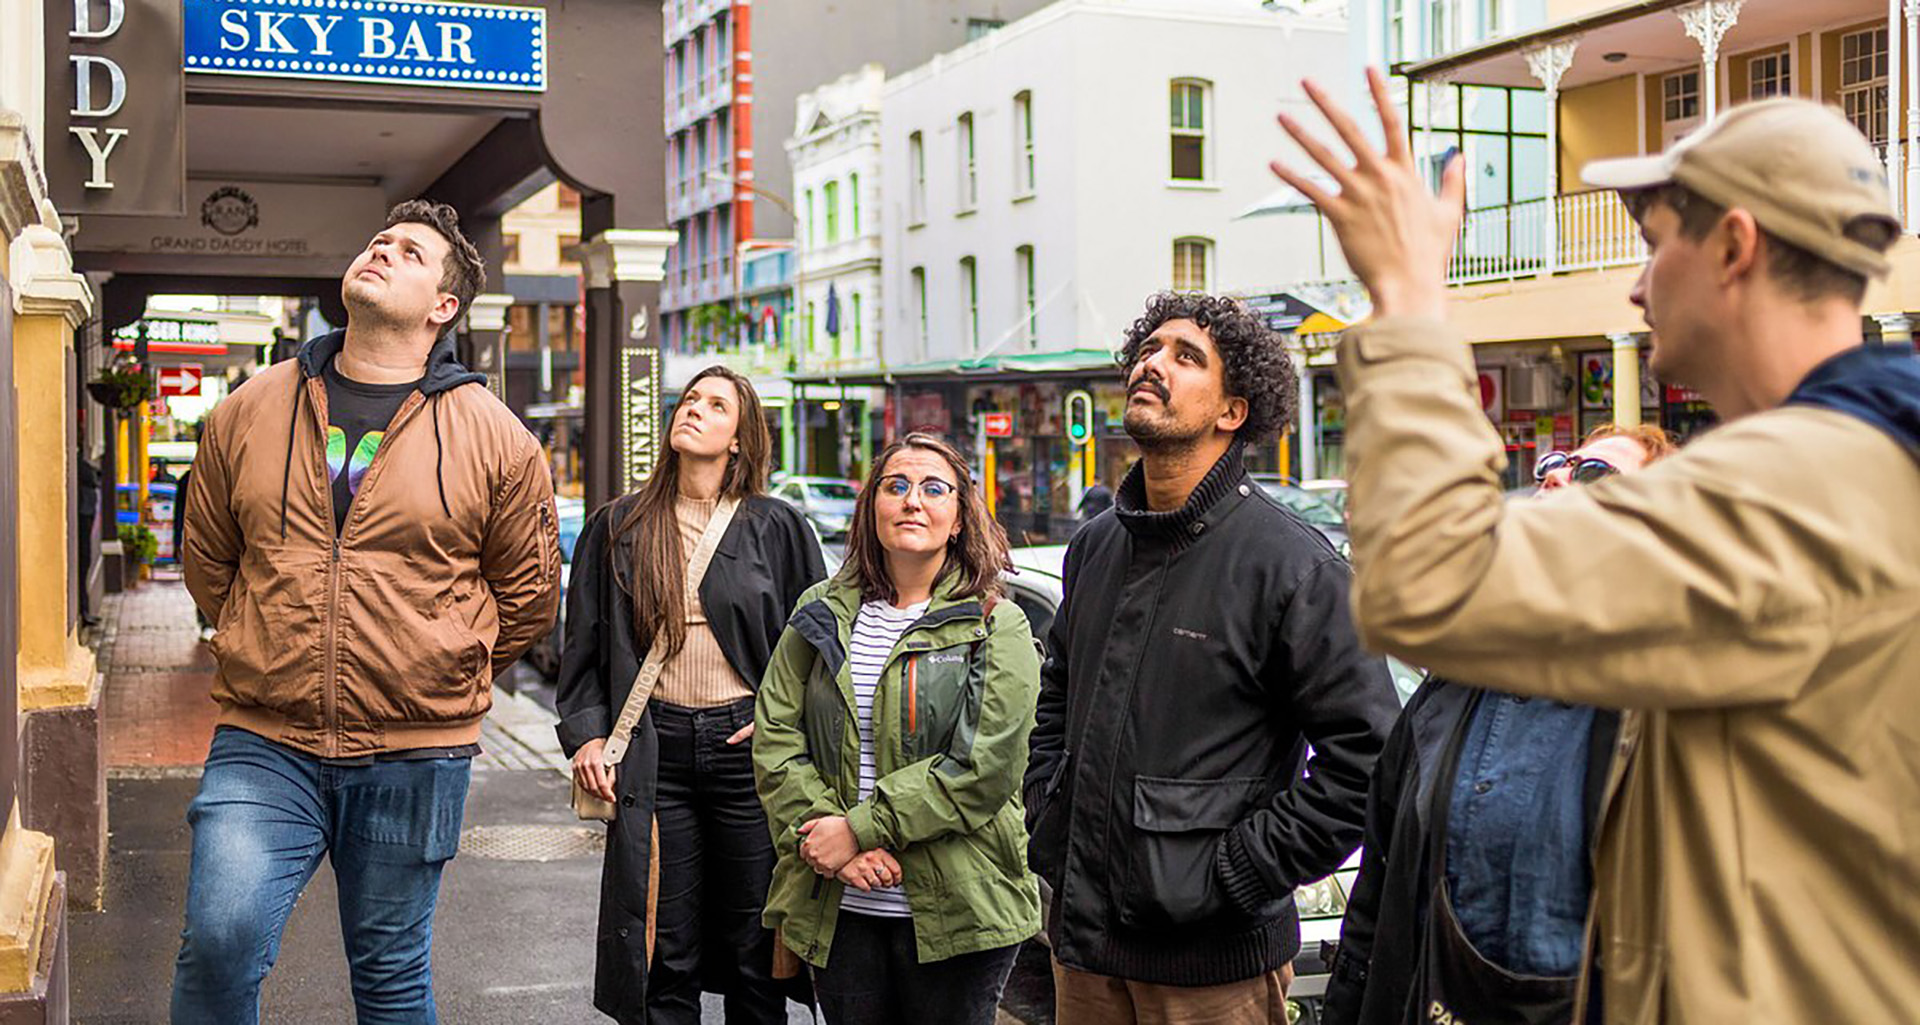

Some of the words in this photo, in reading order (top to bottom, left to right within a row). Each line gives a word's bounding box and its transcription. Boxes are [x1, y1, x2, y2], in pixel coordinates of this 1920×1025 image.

[220, 9, 343, 56] SKY
[358, 17, 476, 64] BAR
[151, 236, 206, 250] GRAND
[210, 238, 263, 251] DADDY
[266, 239, 309, 252] HOTEL
[631, 376, 651, 481] CINEMA
[615, 661, 658, 740] COUNTRY
